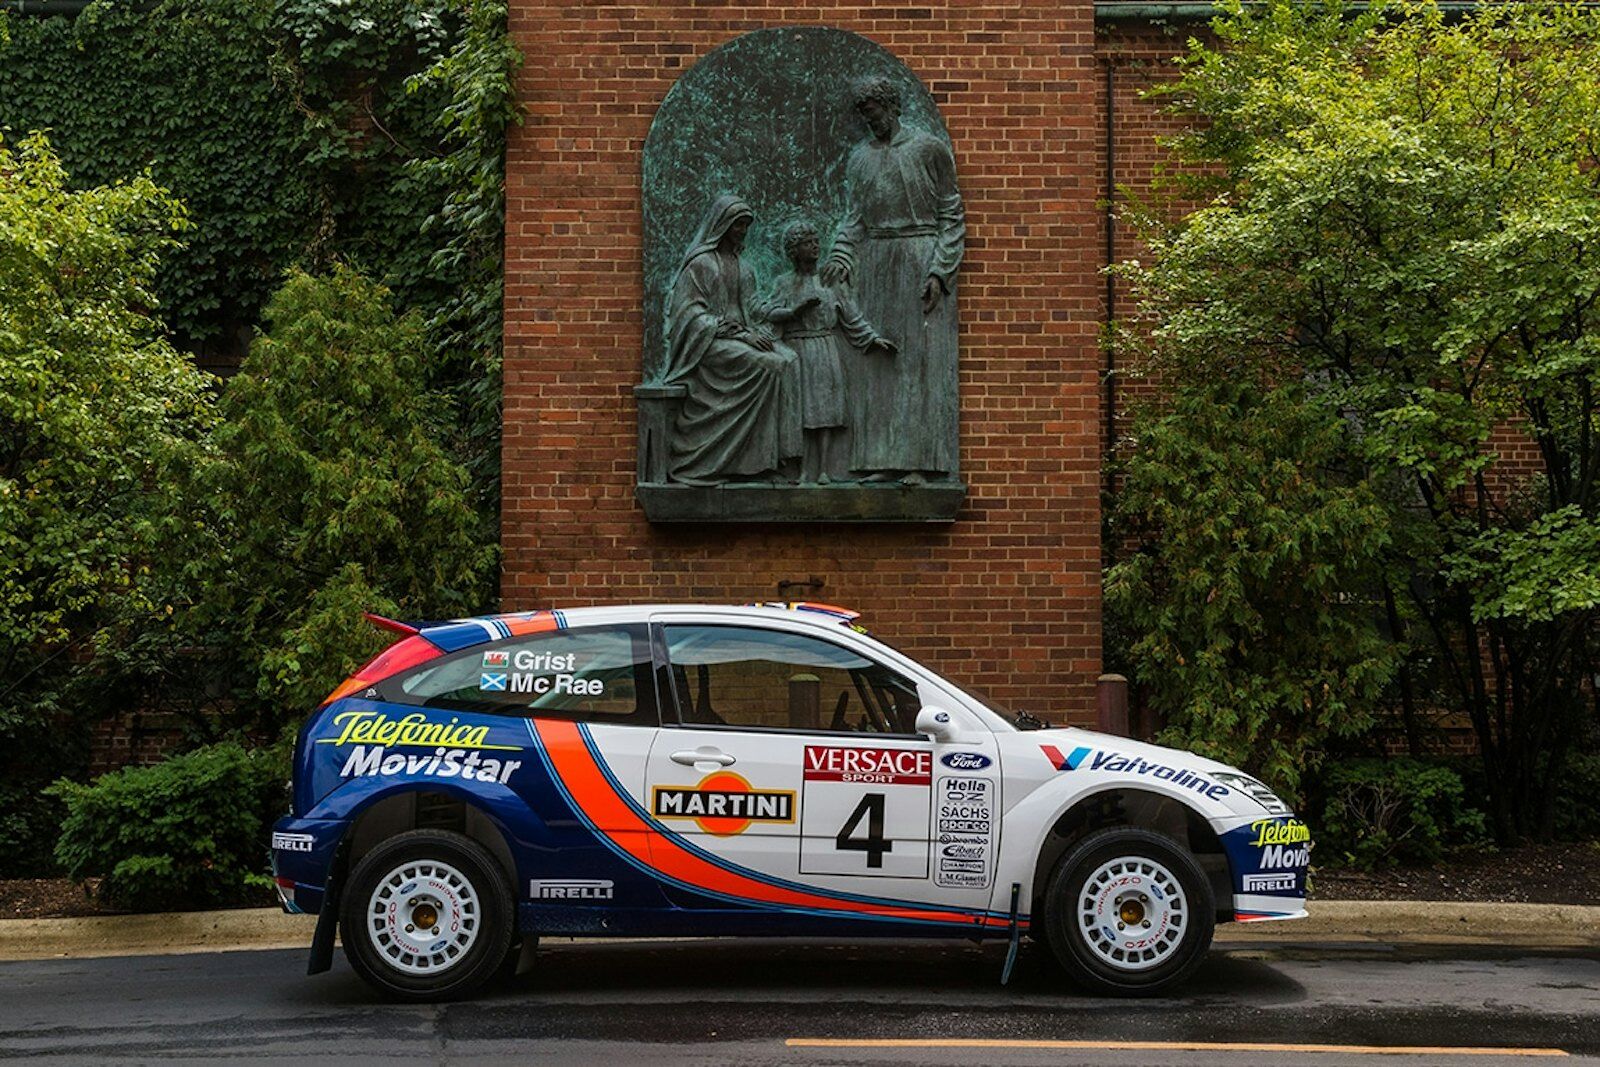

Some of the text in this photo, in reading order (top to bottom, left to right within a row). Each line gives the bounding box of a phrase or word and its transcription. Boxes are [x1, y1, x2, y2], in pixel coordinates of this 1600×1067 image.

[514, 650, 576, 671] Grist
[510, 673, 603, 695] Mc Rae
[340, 745, 521, 784] MoviStar
[808, 748, 930, 774] VERSACE
[950, 752, 982, 769] Ford
[842, 773, 895, 783] SPORT
[946, 780, 986, 791] Hella
[1090, 751, 1229, 801] Valvoline
[660, 792, 787, 818] MARTINI
[941, 806, 989, 819] SACHS
[836, 793, 892, 868] 4
[530, 879, 614, 899] PIRELLI
[1242, 873, 1296, 892] PIRELLI
